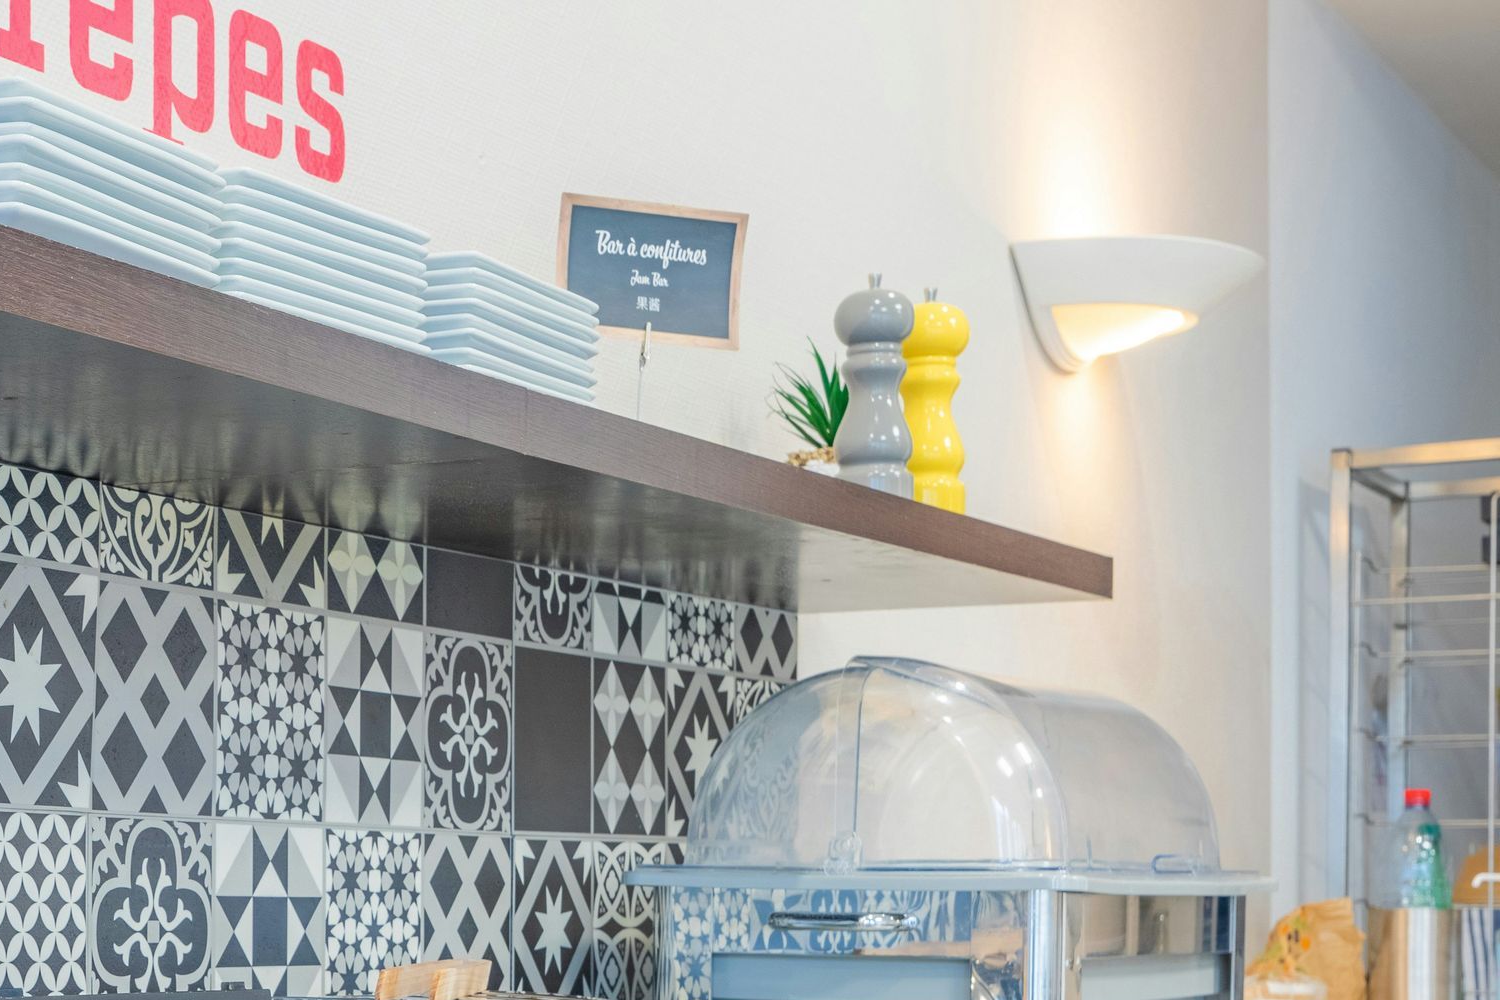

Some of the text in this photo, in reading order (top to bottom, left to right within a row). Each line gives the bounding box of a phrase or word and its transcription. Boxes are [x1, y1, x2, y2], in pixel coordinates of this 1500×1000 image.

[595, 229, 708, 269] Bar à confitures
[630, 269, 669, 287] Jam Bar
